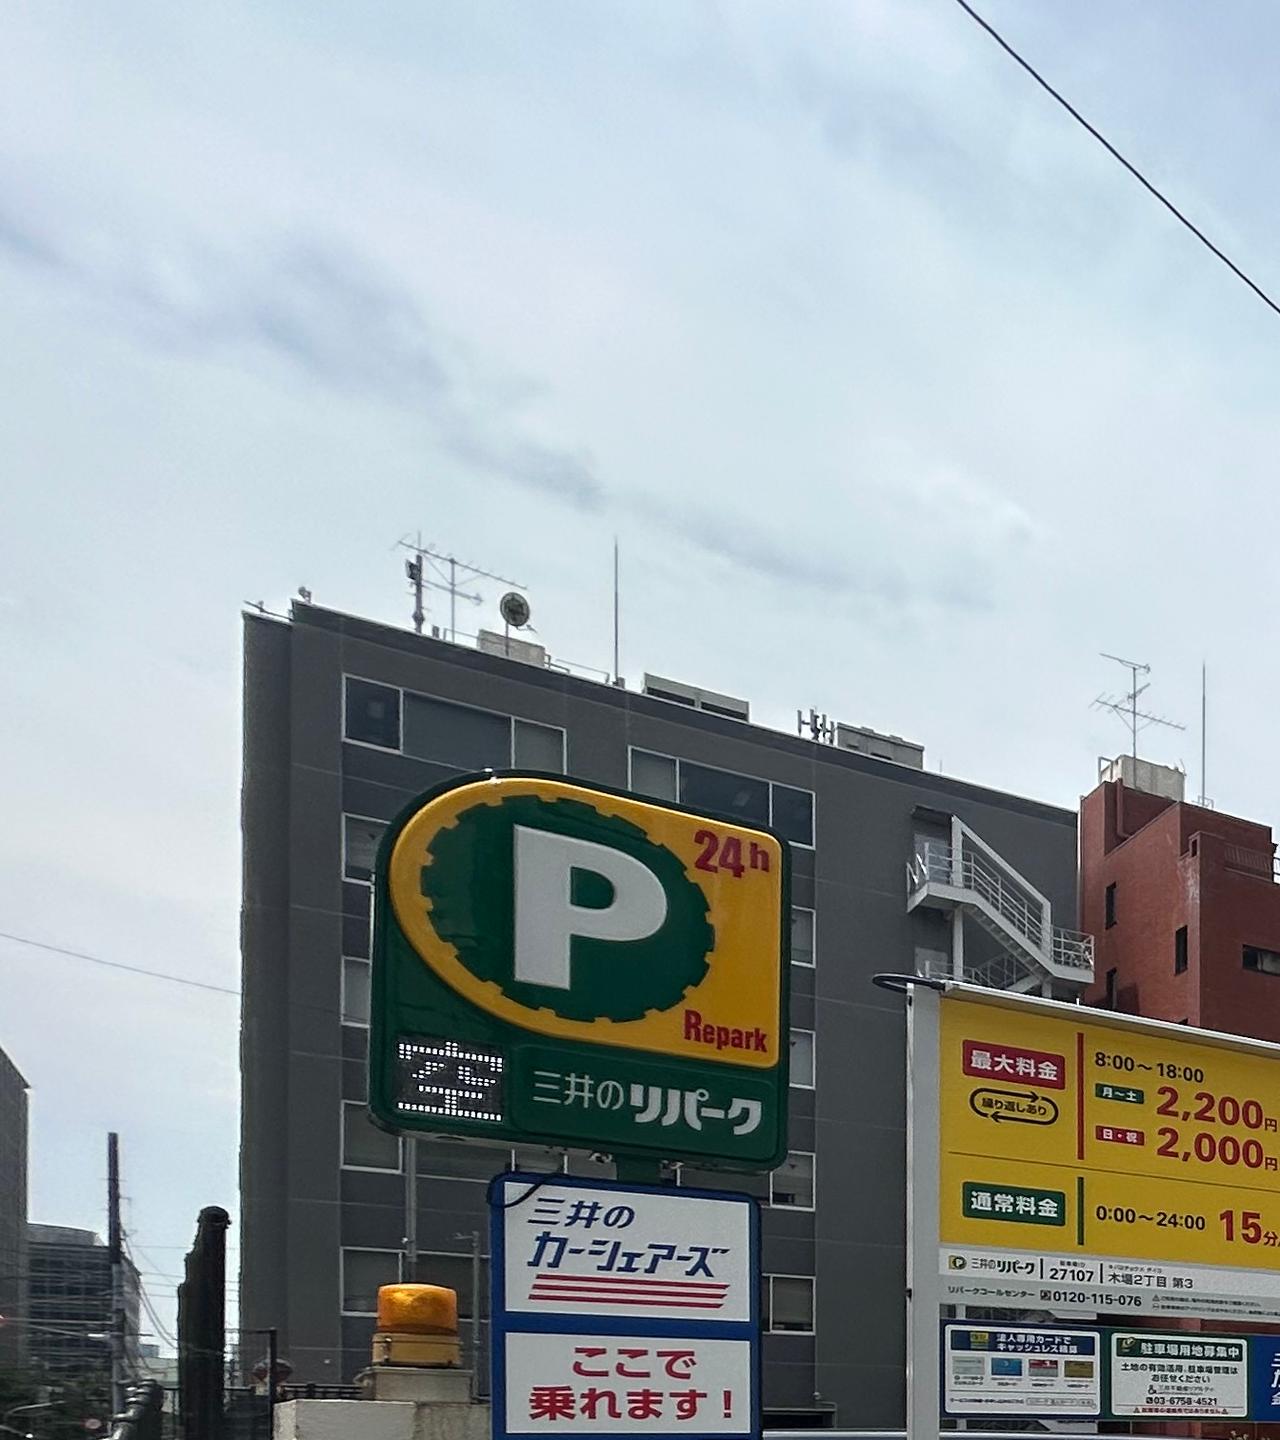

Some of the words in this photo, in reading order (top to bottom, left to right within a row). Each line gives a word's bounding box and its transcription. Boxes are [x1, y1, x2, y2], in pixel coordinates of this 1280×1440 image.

[693, 830, 770, 878] 24h
[513, 823, 667, 990] P
[684, 1009, 767, 1054] Repark
[398, 1041, 503, 1121] 空
[970, 1050, 1058, 1081] 最大料金
[533, 1070, 762, 1136] 三井のリパーク
[982, 1097, 1047, 1116] 繰り返しあり
[1156, 1086, 1278, 1132] 2,200円
[1156, 1127, 1278, 1171] 2,000円
[527, 1198, 635, 1229] 三井の
[971, 1191, 1058, 1218] 通常料金
[527, 1231, 730, 1277] カーシェアーズ
[971, 1257, 1035, 1274] 三井のリパーク
[1049, 1268, 1094, 1282] 27107
[1108, 1273, 1167, 1288] 木場2丁目
[1173, 1277, 1193, 1288] 第3
[948, 1286, 1035, 1298] リパークコールセンター
[1053, 1290, 1142, 1307] 0120-115-076
[572, 1347, 697, 1379] ここで
[1140, 1342, 1239, 1358] 駐車場用地募集中
[529, 1386, 732, 1421] 乗れます！
